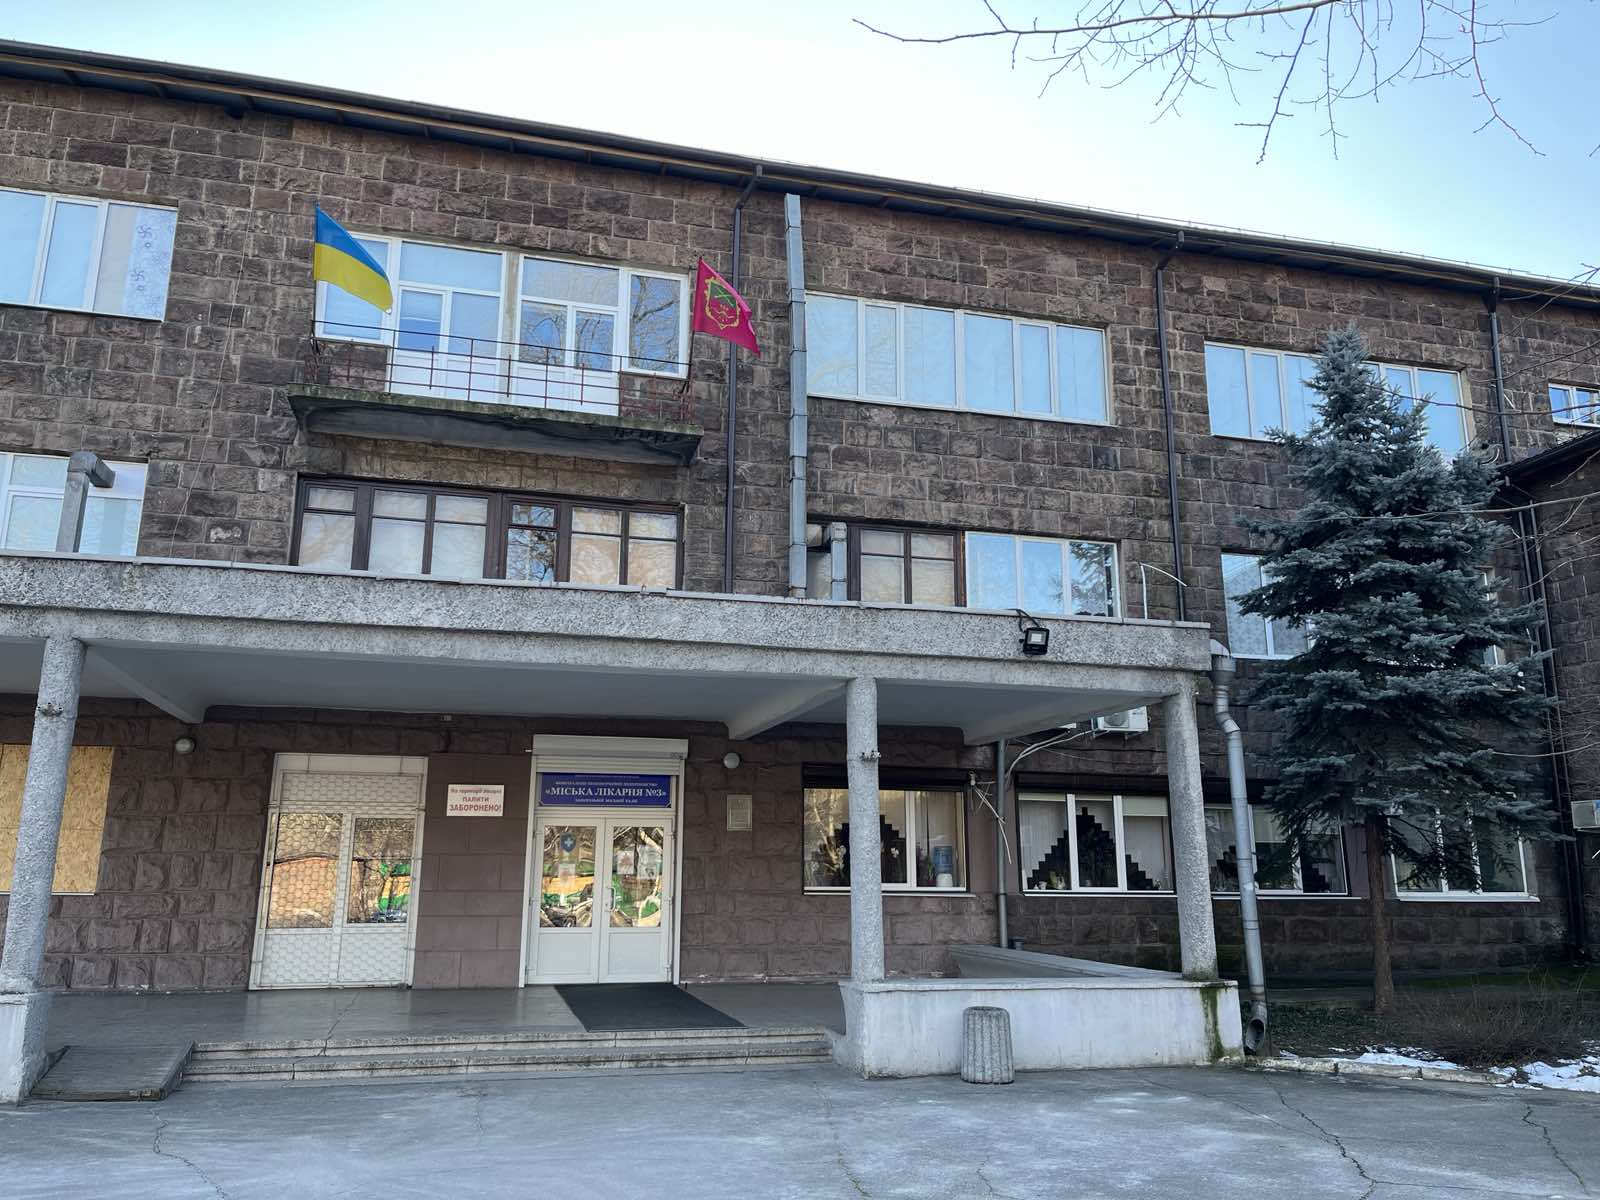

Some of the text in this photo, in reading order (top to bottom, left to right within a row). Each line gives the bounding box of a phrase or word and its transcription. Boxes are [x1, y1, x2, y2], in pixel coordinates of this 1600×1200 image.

[545, 787, 593, 796] «МІСЬКА
[594, 787, 643, 797] ЛІКАРНЯ
[449, 804, 502, 812] ЗАБОРОНЕНО!
